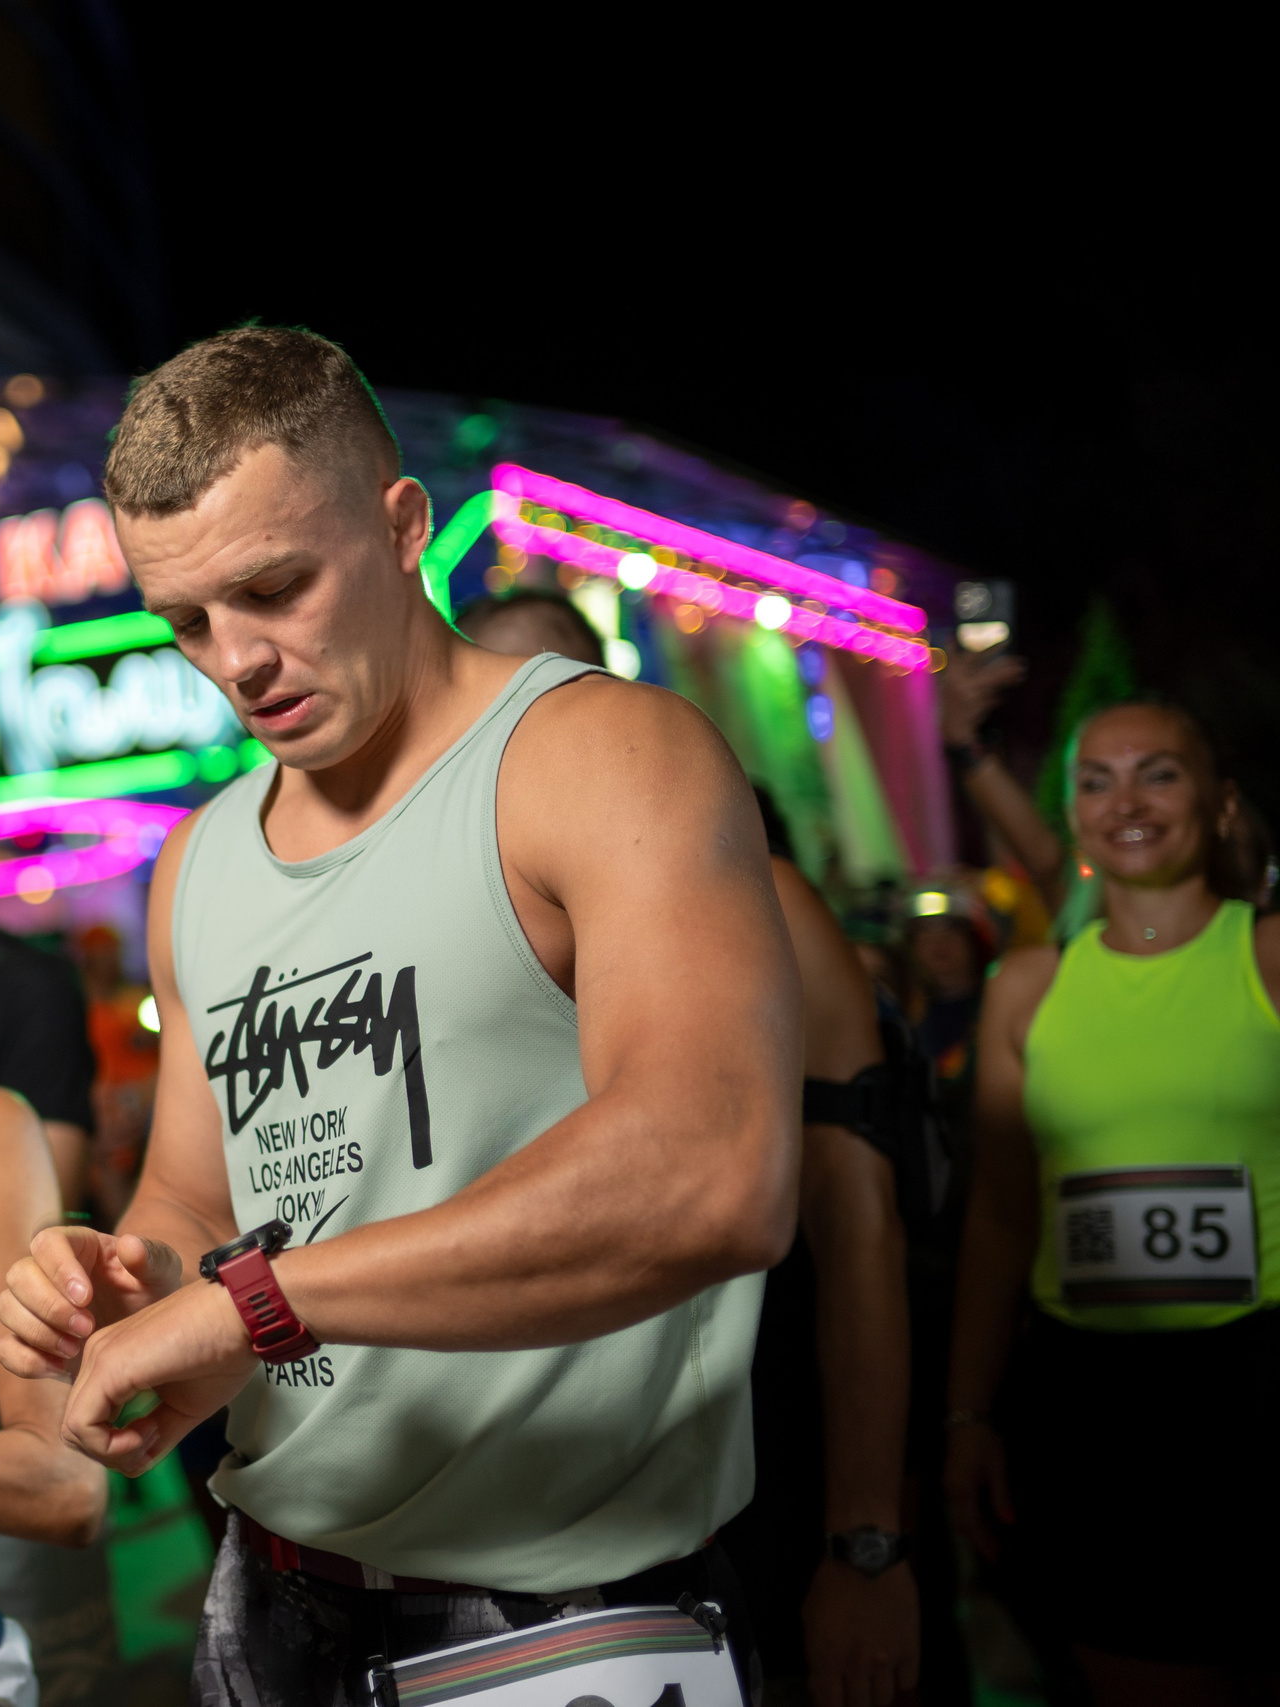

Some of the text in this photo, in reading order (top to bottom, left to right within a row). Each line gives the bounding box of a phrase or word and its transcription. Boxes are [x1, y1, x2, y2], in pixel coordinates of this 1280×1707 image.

[255, 1106, 348, 1155] NEW YORK
[249, 1142, 364, 1194] LOS ANGELES
[276, 1188, 326, 1224] TOKYO
[1143, 1205, 1230, 1262] 85
[264, 1356, 335, 1387] PARIS
